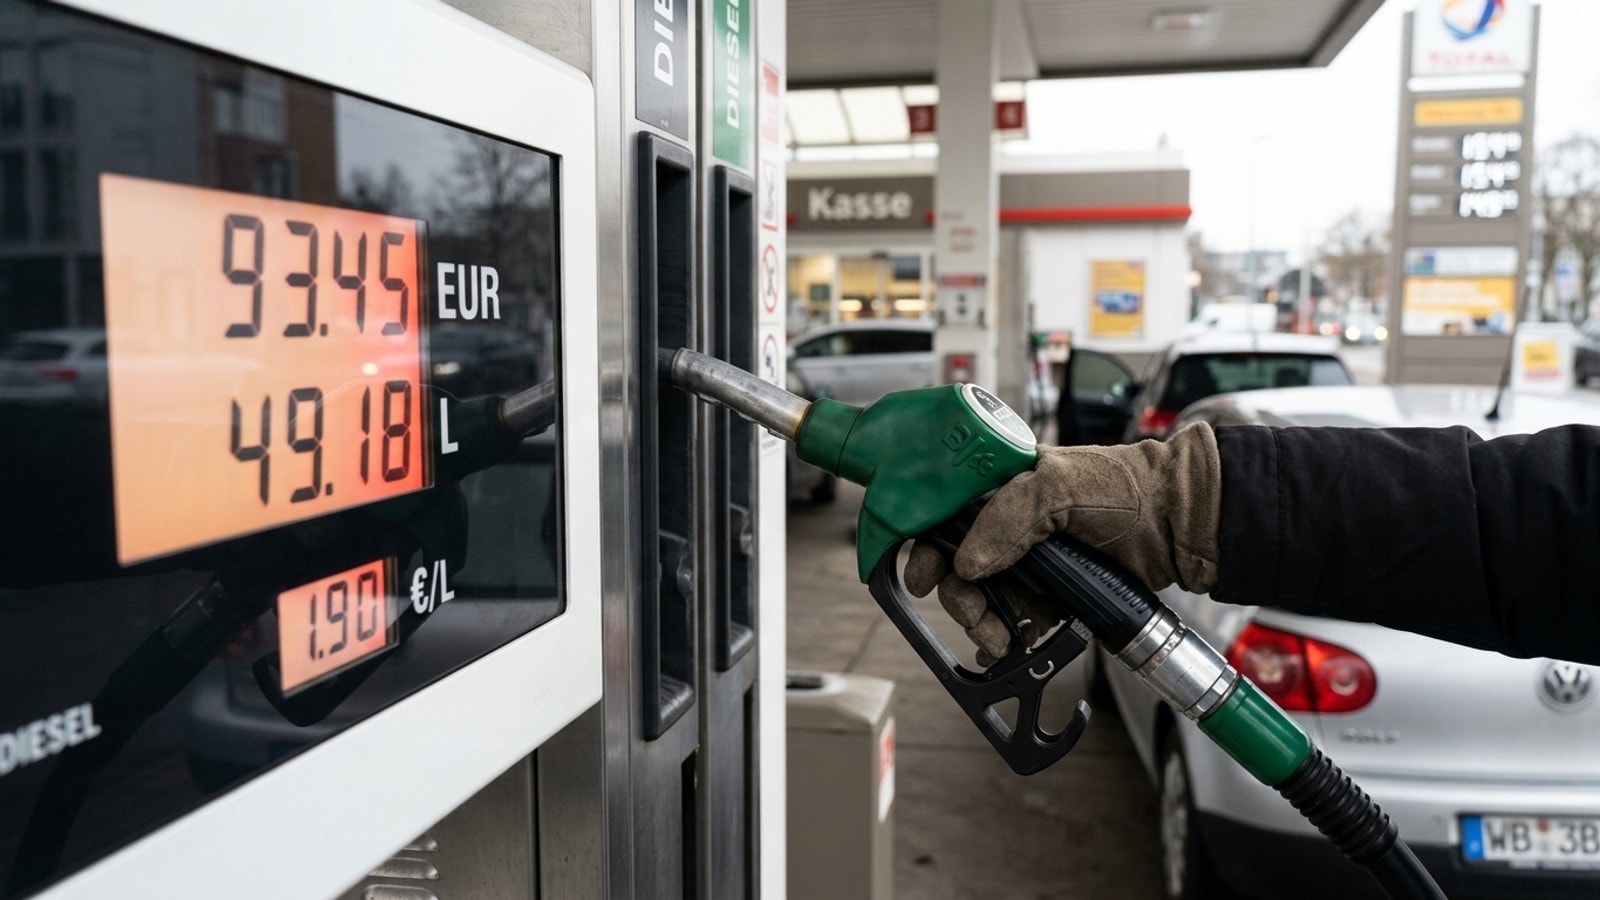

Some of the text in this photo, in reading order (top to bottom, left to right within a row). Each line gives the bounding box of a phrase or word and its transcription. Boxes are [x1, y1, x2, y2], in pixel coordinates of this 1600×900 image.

[654, 0, 674, 87] DIE
[808, 187, 913, 220] Kasse
[222, 213, 500, 338] 93.45 EUR
[230, 379, 458, 506] 49.18 L
[309, 559, 455, 661] 1.90 €/L
[0, 702, 102, 777] DIESEL
[1486, 821, 1532, 852] WB
